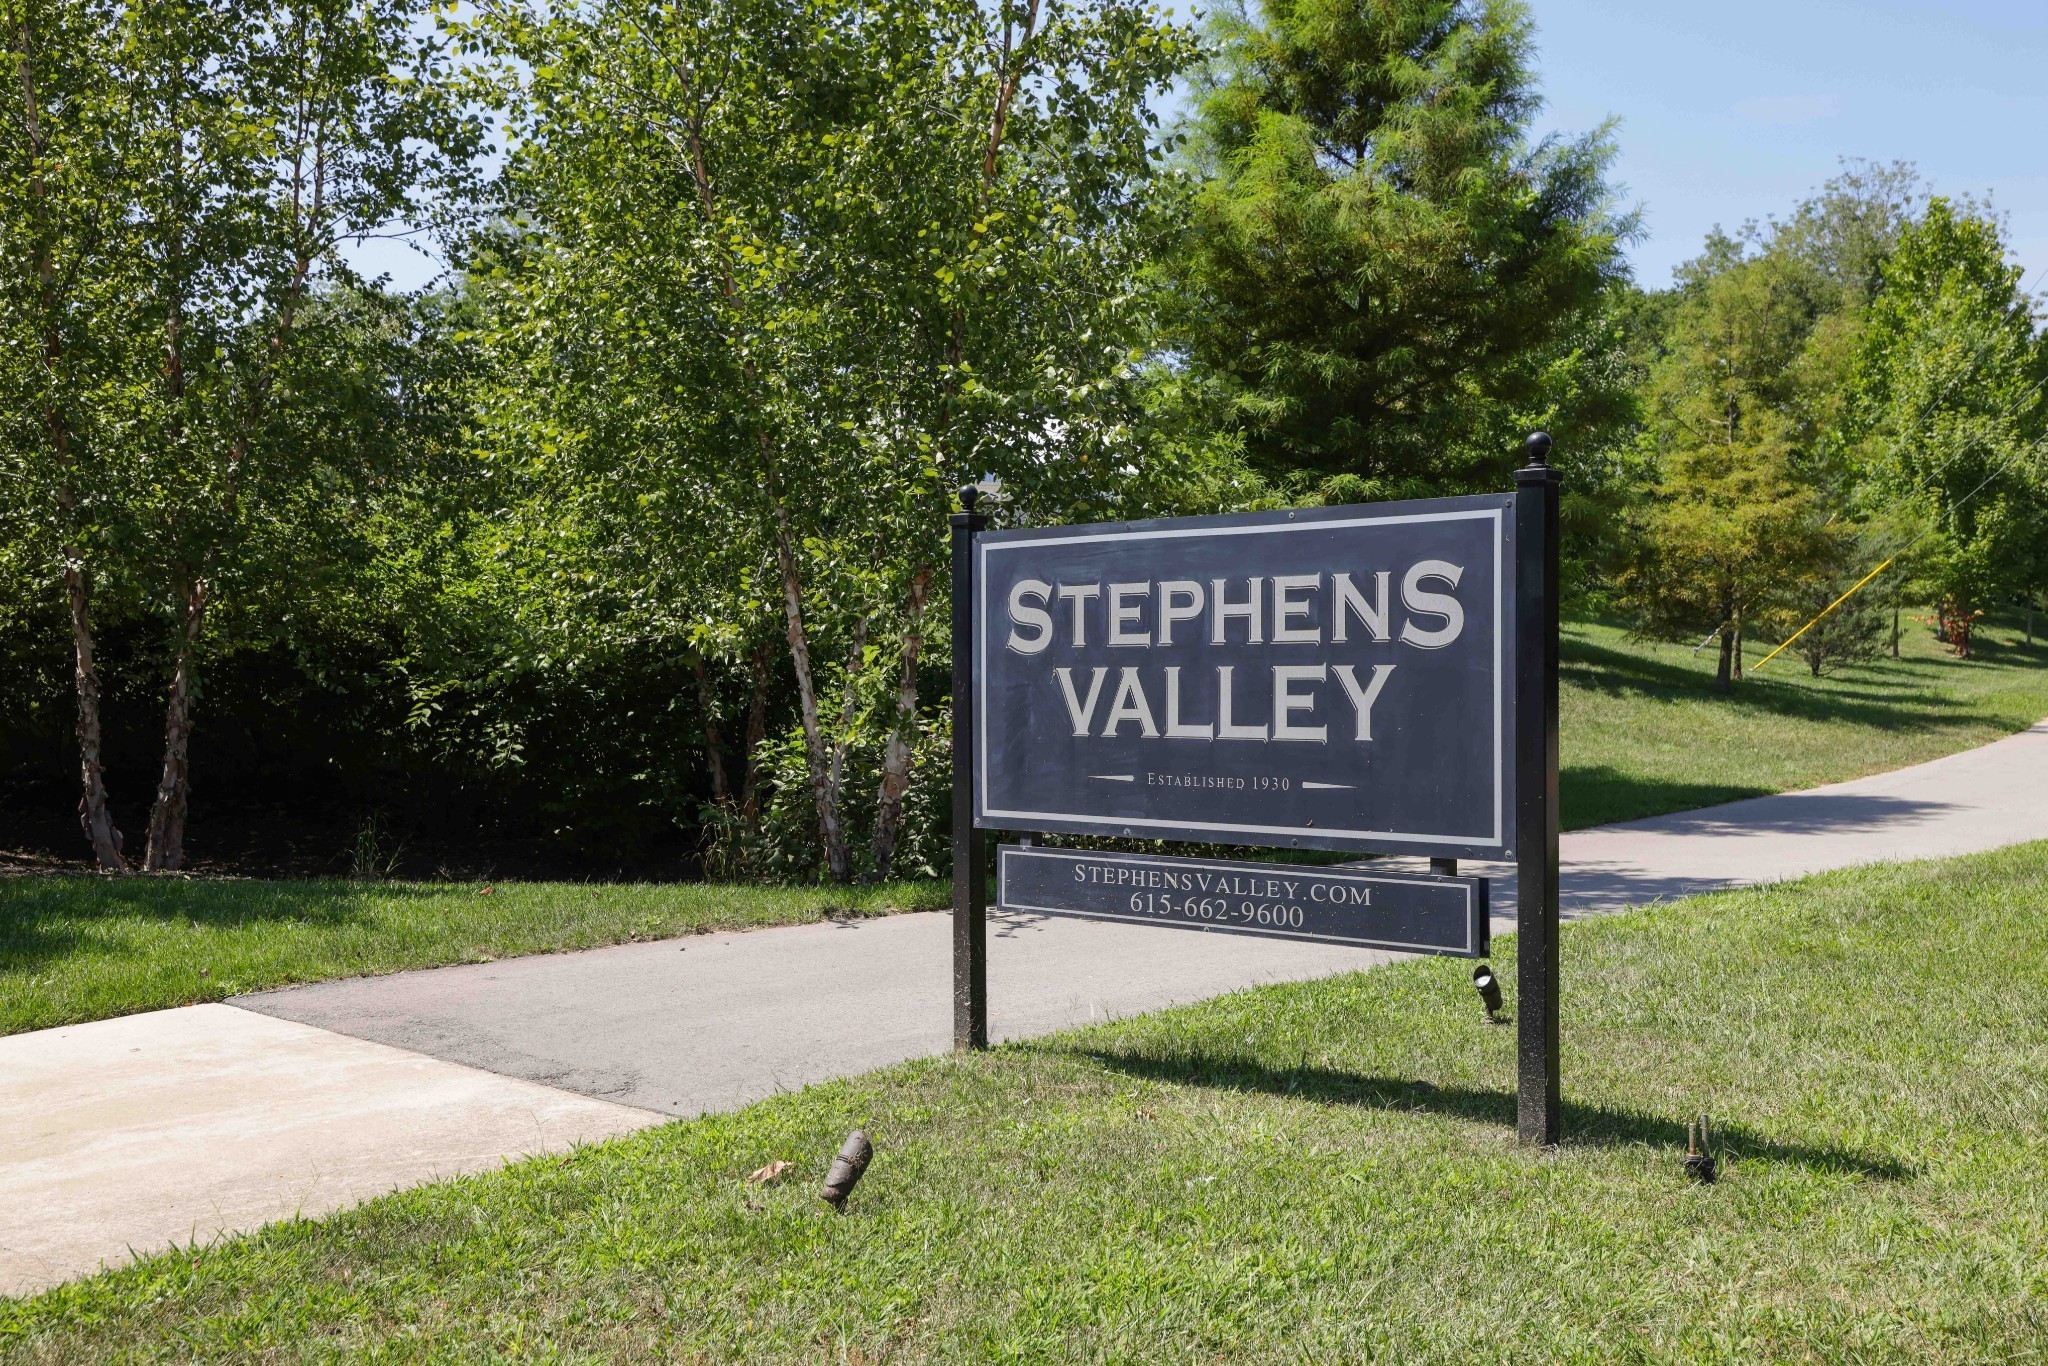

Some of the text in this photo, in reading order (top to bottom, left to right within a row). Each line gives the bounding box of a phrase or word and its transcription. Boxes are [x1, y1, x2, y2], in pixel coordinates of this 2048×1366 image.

[1006, 559, 1465, 656] STEPHENS
[1055, 662, 1397, 744] VALLEY
[1147, 772, 1290, 791] ESTABLISHED 1930
[1074, 864, 1372, 905] STEPHENSVALLEY.COM
[1130, 892, 1304, 928] 615-662-9600
